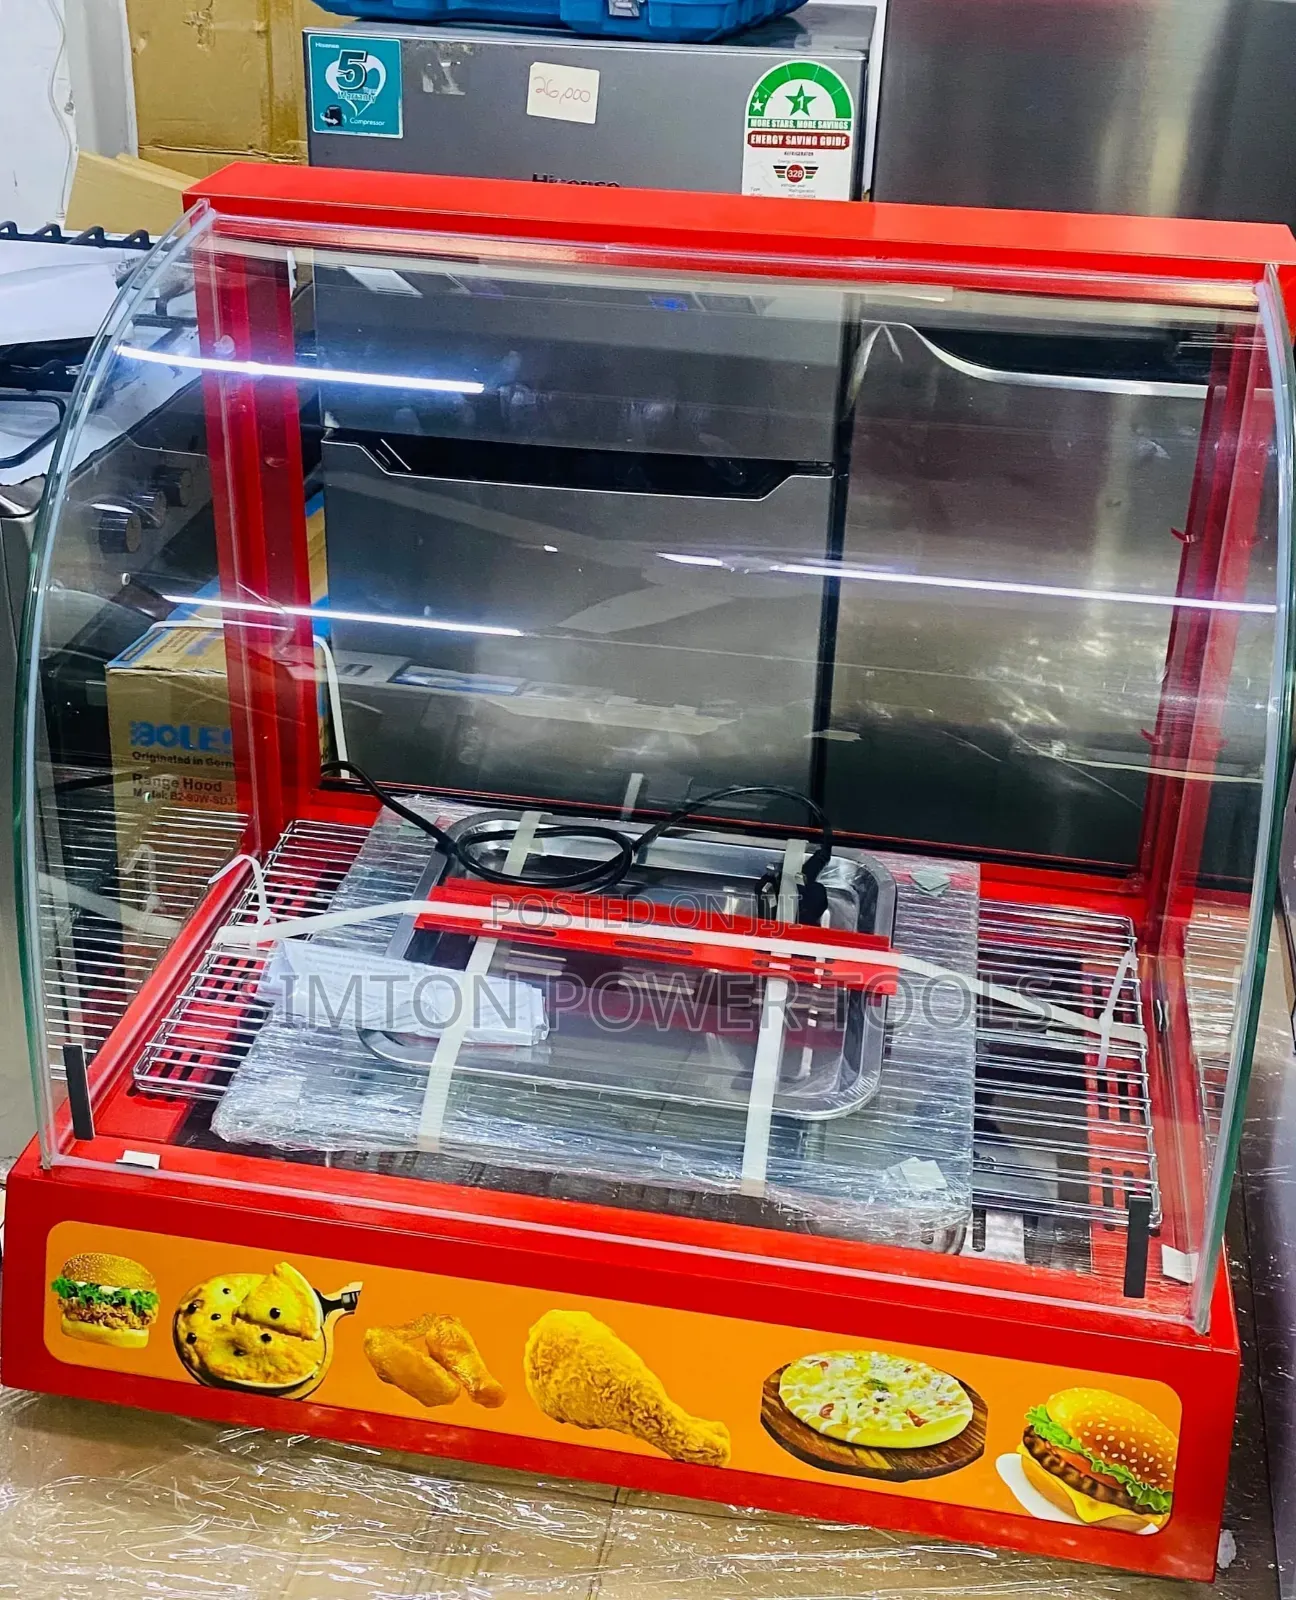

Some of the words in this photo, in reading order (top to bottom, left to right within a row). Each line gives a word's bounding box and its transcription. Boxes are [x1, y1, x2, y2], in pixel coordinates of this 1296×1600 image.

[336, 49, 368, 90] 5
[533, 76, 591, 104] 26,000
[338, 91, 377, 104] Warranty
[349, 117, 386, 126] Compressor
[750, 119, 771, 128] MORE
[796, 121, 817, 129] MORE
[817, 121, 849, 130] SAVINGS
[750, 134, 784, 145] ENERGY
[785, 135, 818, 146] SAVING
[819, 136, 847, 147] GUIDE
[787, 169, 804, 179] 328
[132, 751, 191, 765] Originated
[193, 756, 204, 765] in
[132, 772, 180, 791] Range
[183, 777, 223, 793] Hood
